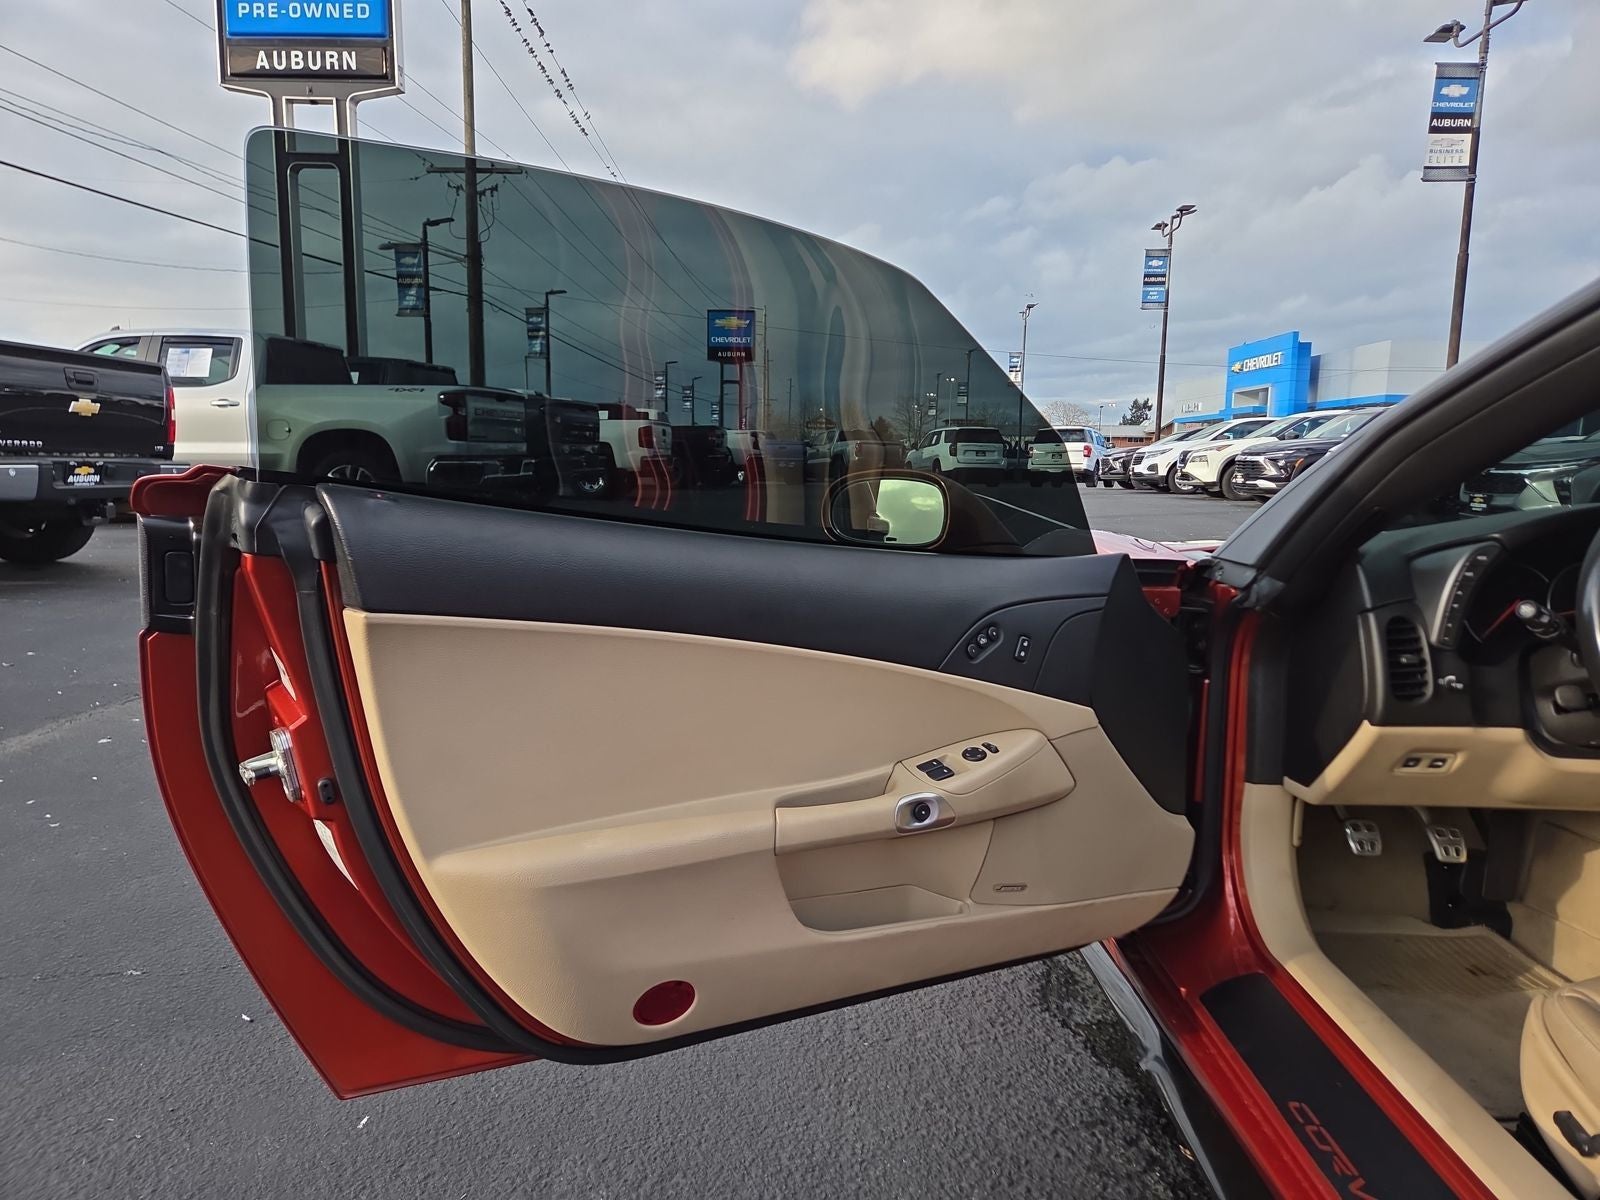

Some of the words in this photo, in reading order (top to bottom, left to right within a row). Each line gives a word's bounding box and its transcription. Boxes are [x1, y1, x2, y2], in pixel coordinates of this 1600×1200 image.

[238, 3, 370, 18] PRE-OWNED
[255, 50, 357, 71] AUBURN
[1430, 119, 1471, 127] AUBURN
[1429, 156, 1463, 164] ELITE
[1243, 351, 1283, 372] CHEVROLET
[68, 474, 100, 482] AUBURN
